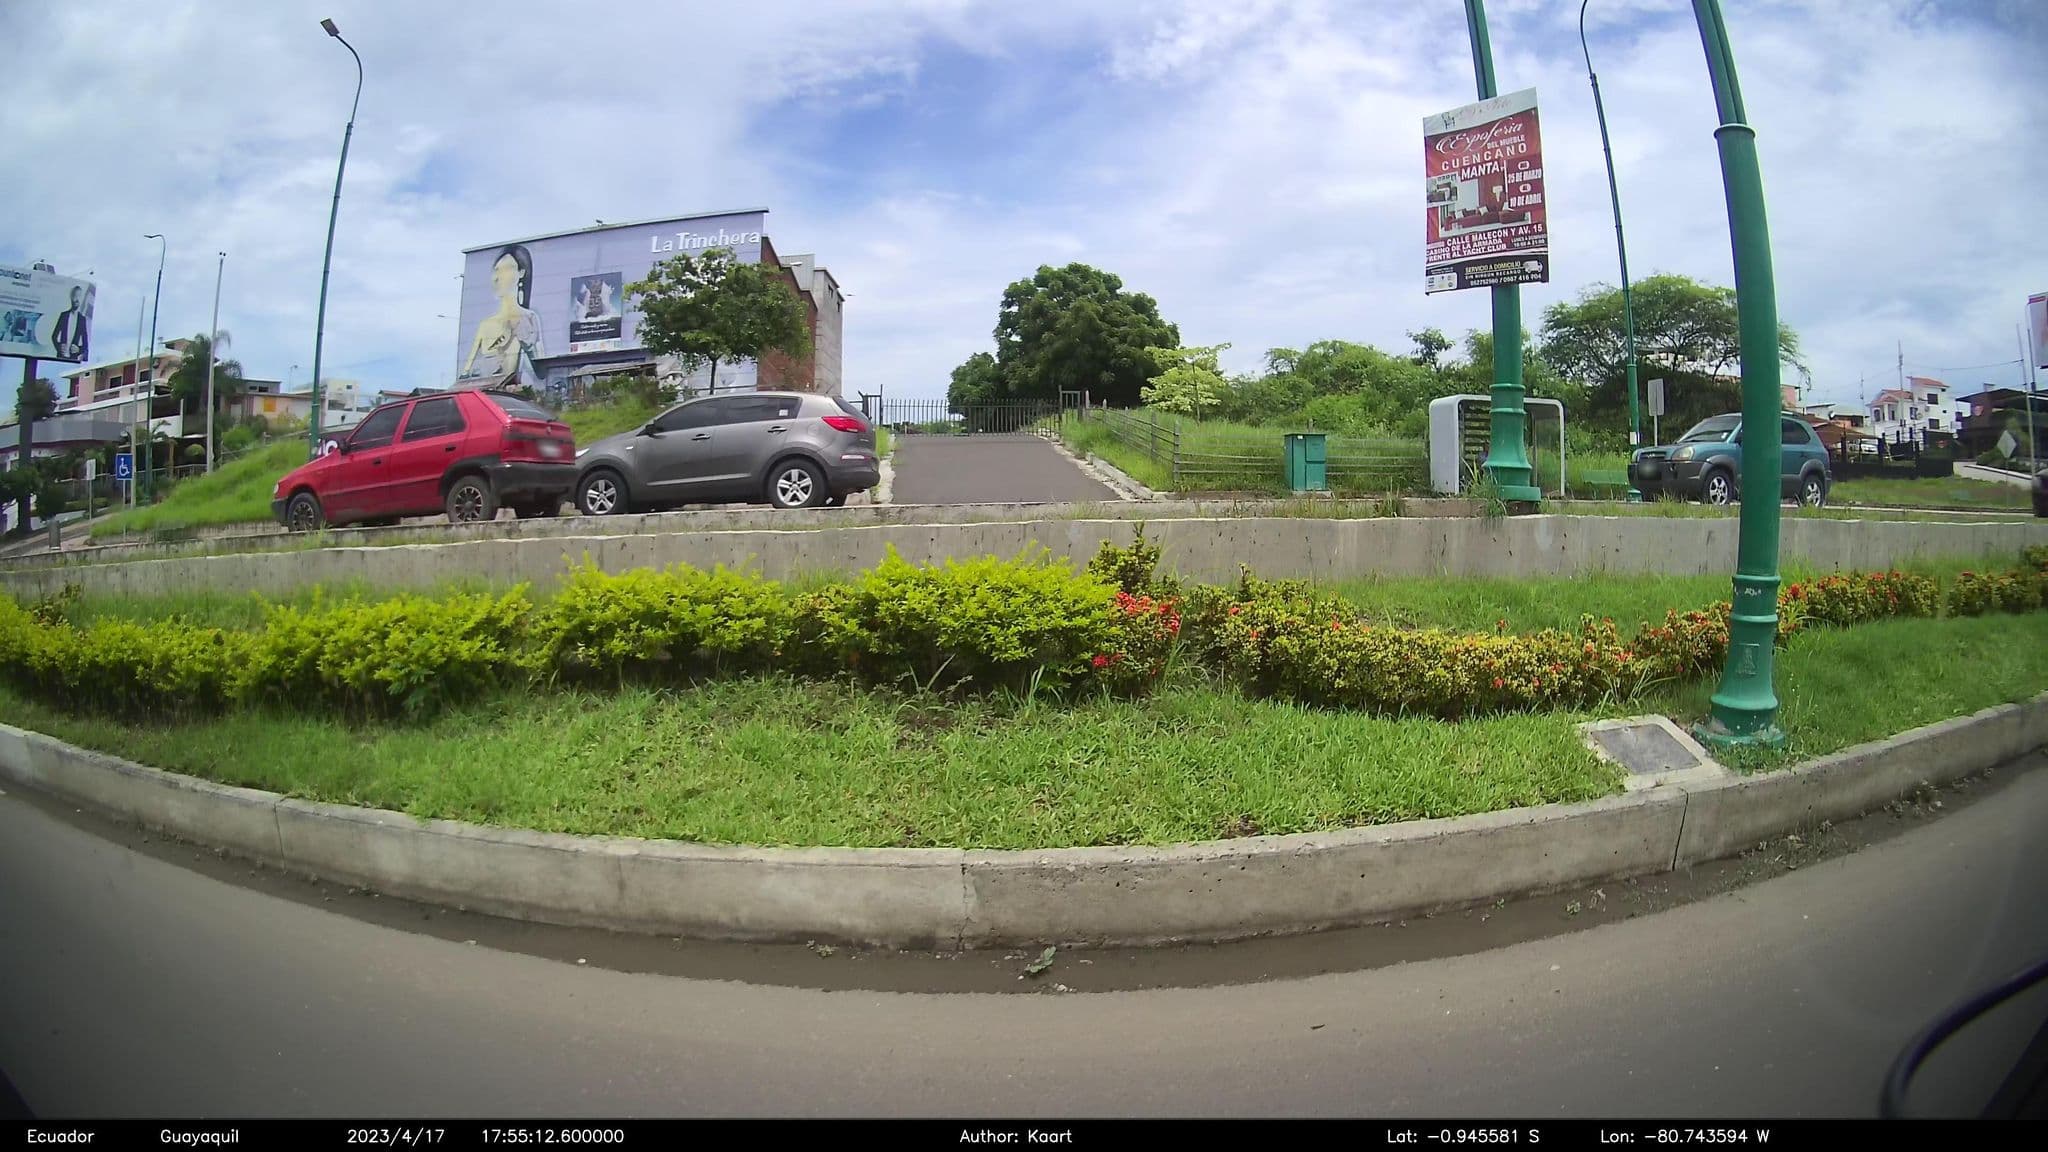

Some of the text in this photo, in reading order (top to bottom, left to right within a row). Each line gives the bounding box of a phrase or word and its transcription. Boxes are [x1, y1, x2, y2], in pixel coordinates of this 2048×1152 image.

[1500, 134, 1525, 146] MUEBLE
[1442, 142, 1527, 171] CUENCANO
[651, 228, 761, 254] La Trinchera
[1447, 234, 1470, 247] CALLE
[1510, 227, 1516, 236] Y
[1518, 225, 1531, 236] AV.
[1533, 223, 1543, 233] 15
[1451, 244, 1461, 252] DE
[1462, 242, 1472, 250] LA
[1473, 238, 1503, 249] ARMADA
[1452, 251, 1460, 259] AL
[1487, 243, 1507, 253] CLUB
